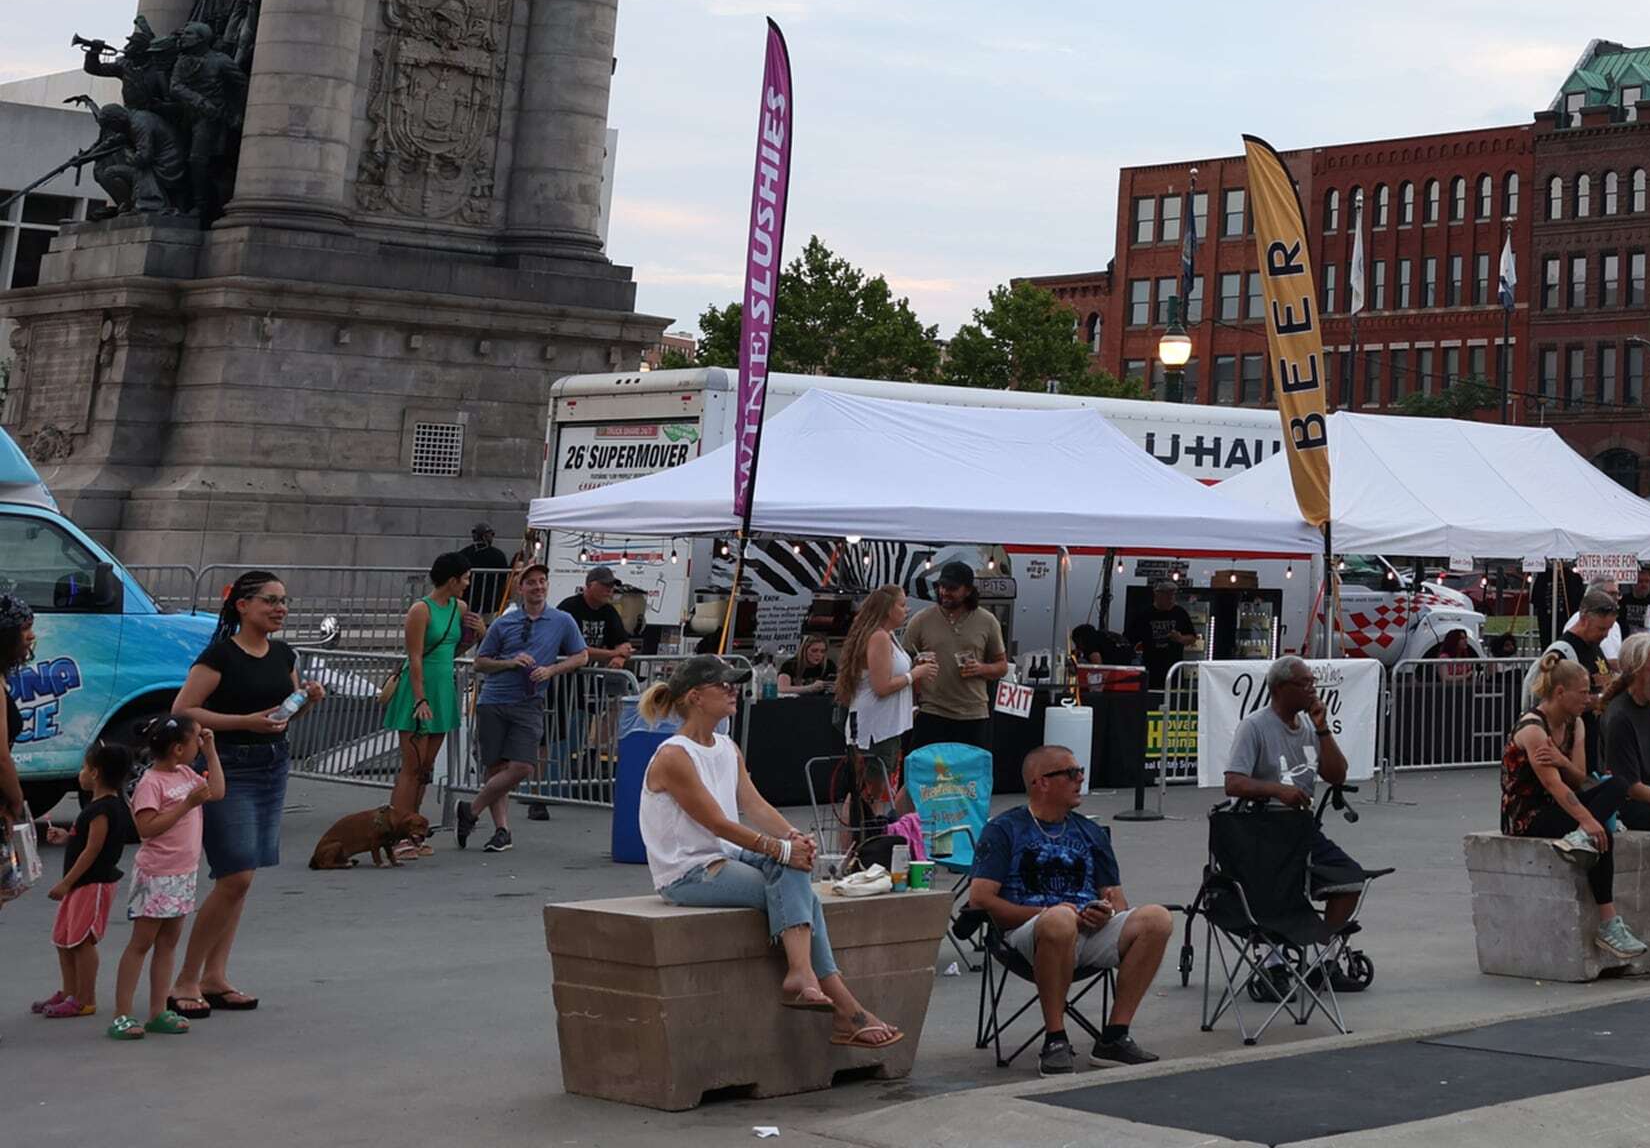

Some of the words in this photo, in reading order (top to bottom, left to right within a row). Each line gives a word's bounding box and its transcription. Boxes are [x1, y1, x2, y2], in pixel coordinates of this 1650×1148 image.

[750, 84, 786, 326] SLUSHIES
[1265, 238, 1329, 452] BEER
[587, 443, 689, 469] SUPERMOVER
[1144, 432, 1281, 469] U-HAU
[1579, 554, 1601, 567] ENTER
[1603, 554, 1620, 567] HERE
[1622, 554, 1637, 568] FOR
[1612, 569, 1637, 582] TICKETS
[982, 580, 1008, 591] PITS
[5, 656, 82, 702] ONA
[996, 682, 1034, 711] EXIT
[13, 700, 60, 744] CE
